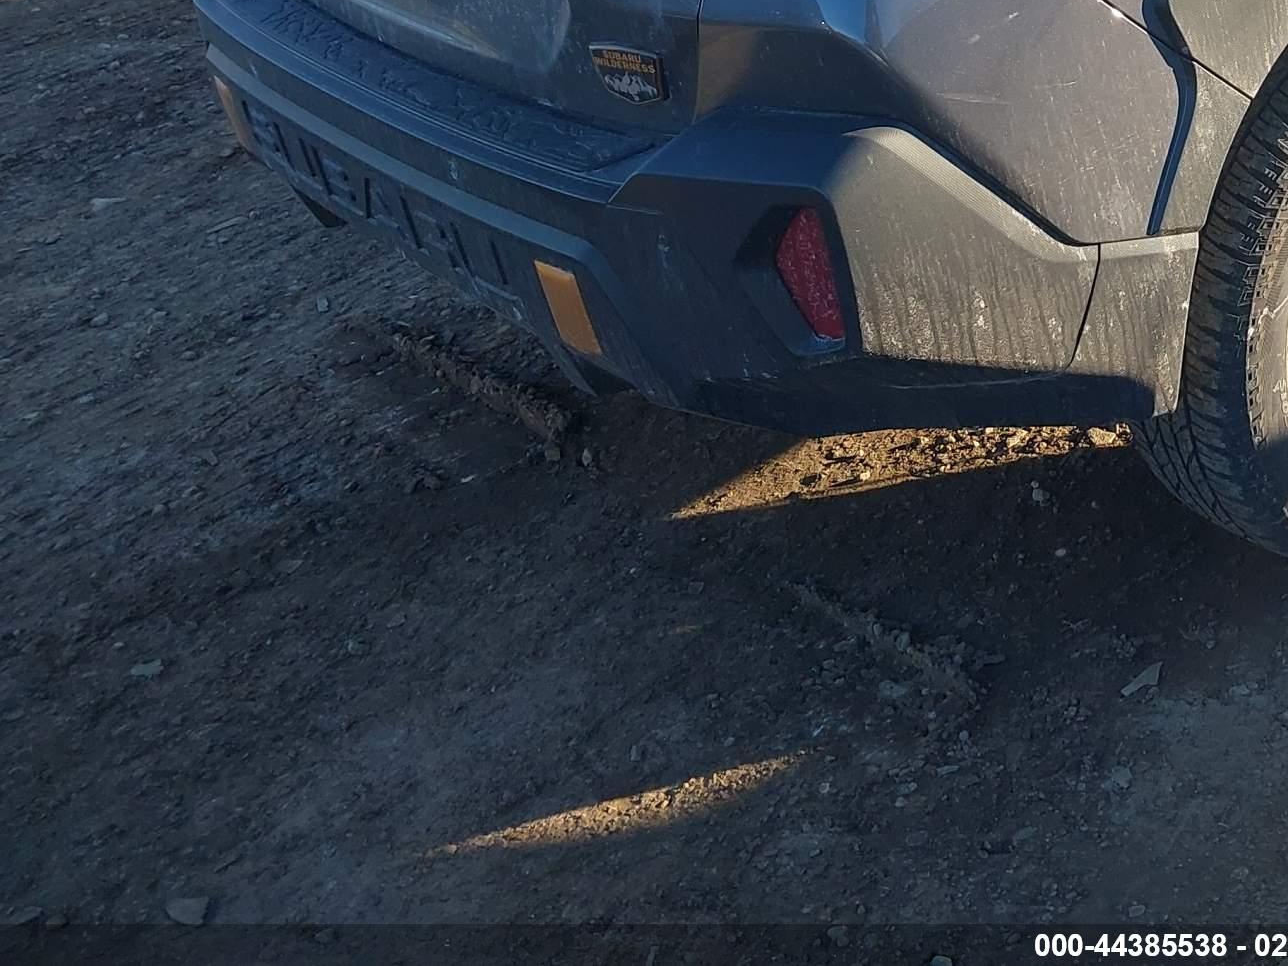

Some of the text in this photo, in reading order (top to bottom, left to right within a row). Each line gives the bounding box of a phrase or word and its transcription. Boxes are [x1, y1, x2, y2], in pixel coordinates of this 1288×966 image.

[592, 55, 656, 75] WILDERNESS
[602, 50, 642, 64] SUBARU
[240, 98, 521, 301] SUBARU
